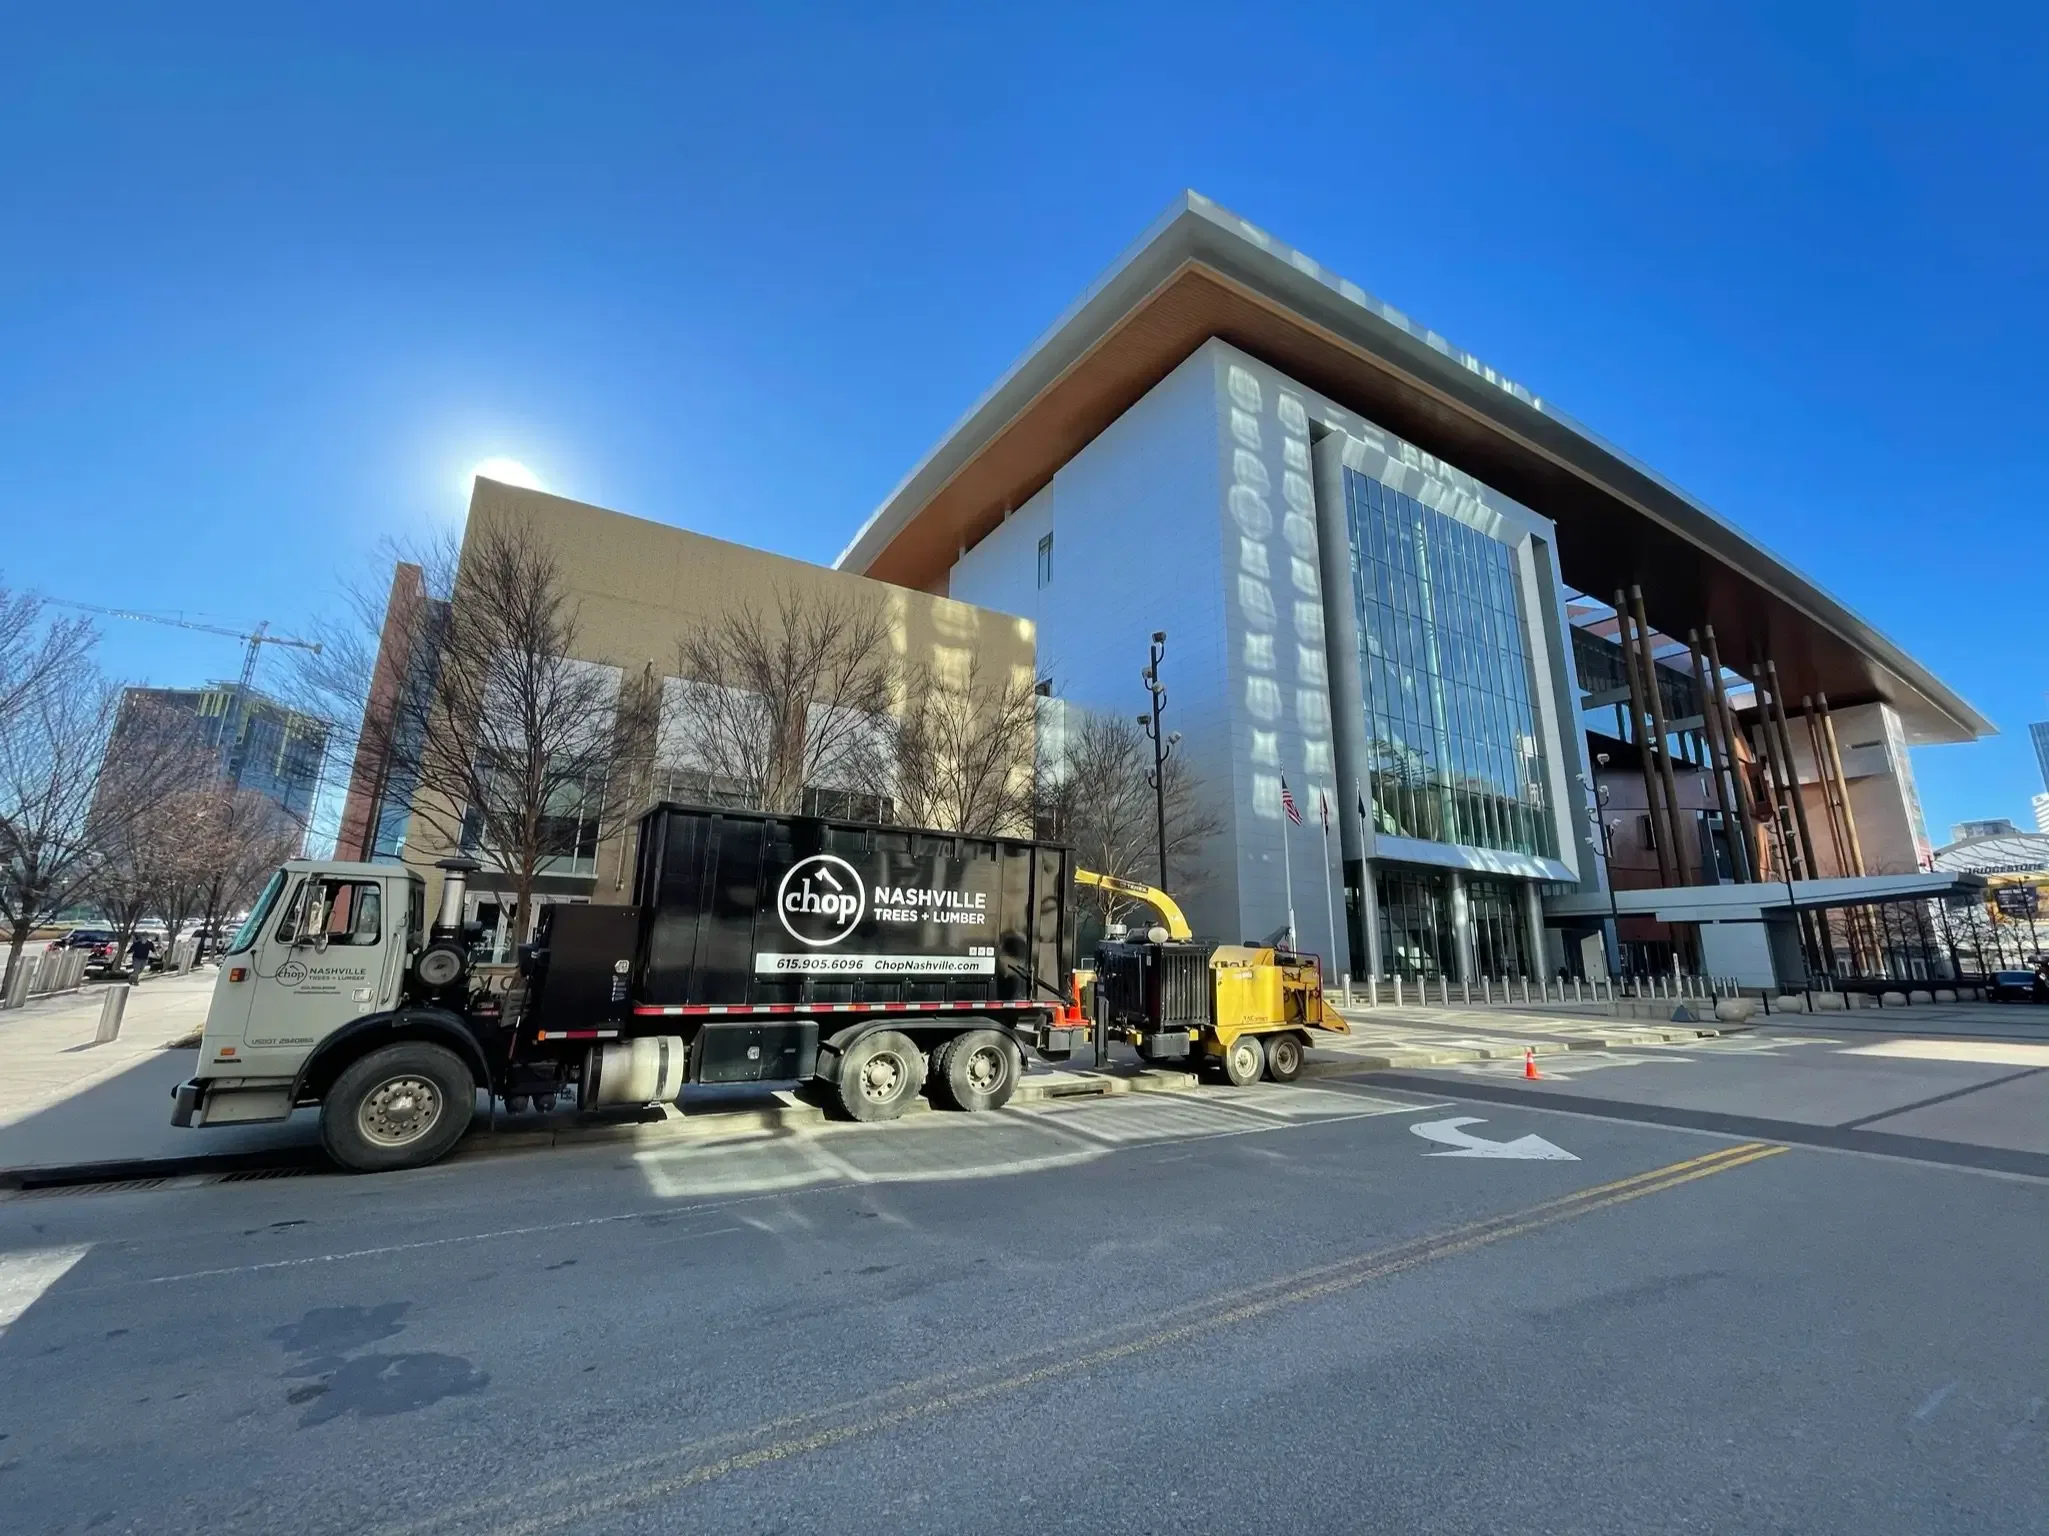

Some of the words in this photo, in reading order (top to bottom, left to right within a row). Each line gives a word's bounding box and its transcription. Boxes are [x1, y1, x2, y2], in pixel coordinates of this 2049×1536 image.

[785, 878, 858, 925] chop
[874, 886, 987, 909] NASHVILLE
[873, 908, 918, 922] TREES
[933, 911, 985, 925] LUMBER
[309, 967, 367, 975] NASHVILLE
[776, 958, 864, 971] 615.905.6096
[874, 959, 980, 972] ChopNashville.com
[277, 967, 305, 981] chop
